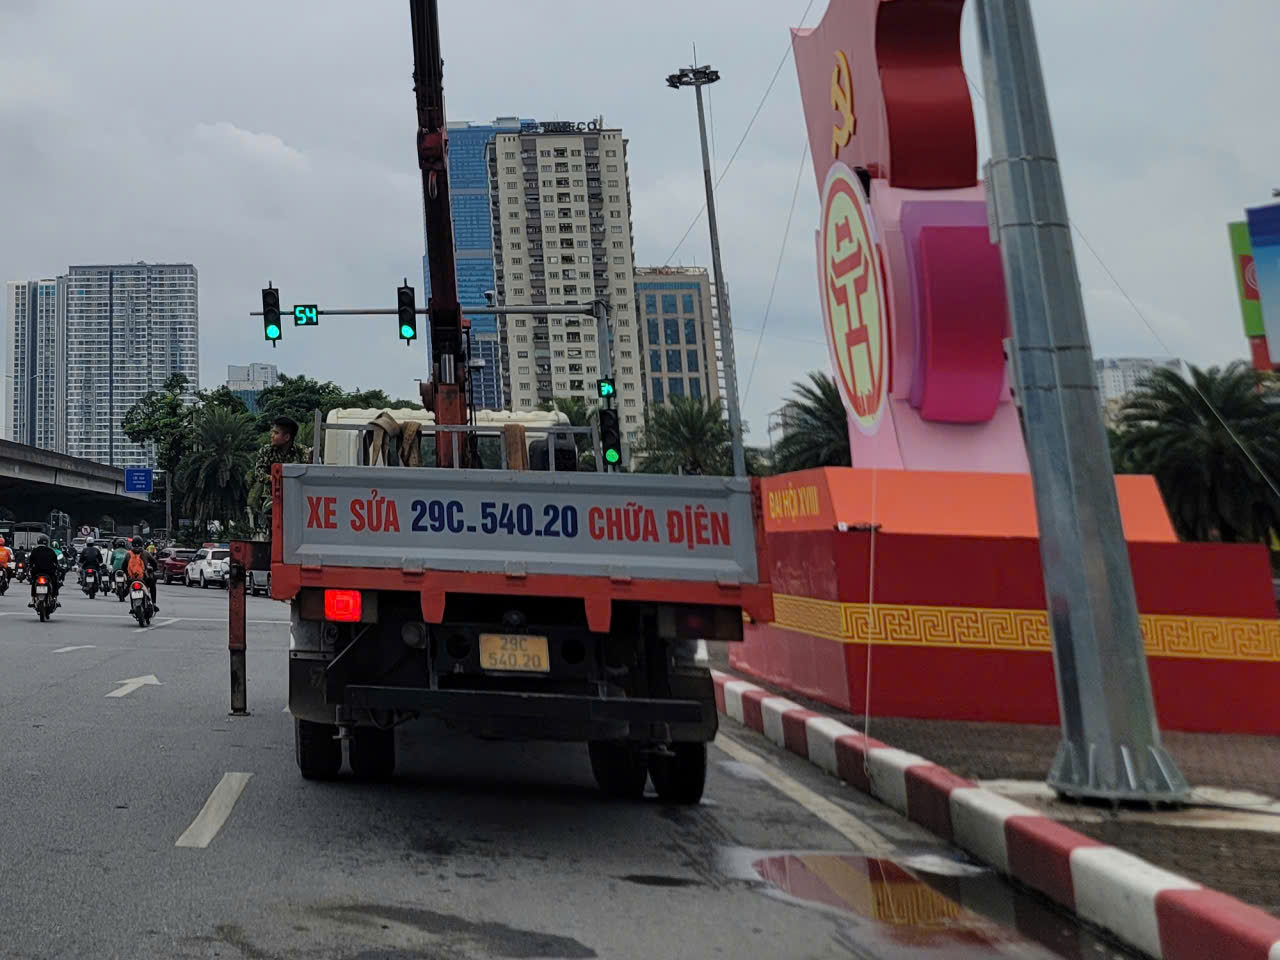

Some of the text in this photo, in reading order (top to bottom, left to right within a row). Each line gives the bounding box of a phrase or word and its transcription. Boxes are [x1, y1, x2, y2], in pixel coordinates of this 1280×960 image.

[295, 306, 317, 324] 54
[307, 496, 337, 529] XE
[350, 489, 400, 533] SỬA
[589, 501, 660, 543] CHỮA
[500, 637, 528, 652] 29C
[487, 652, 542, 668] 540.20
